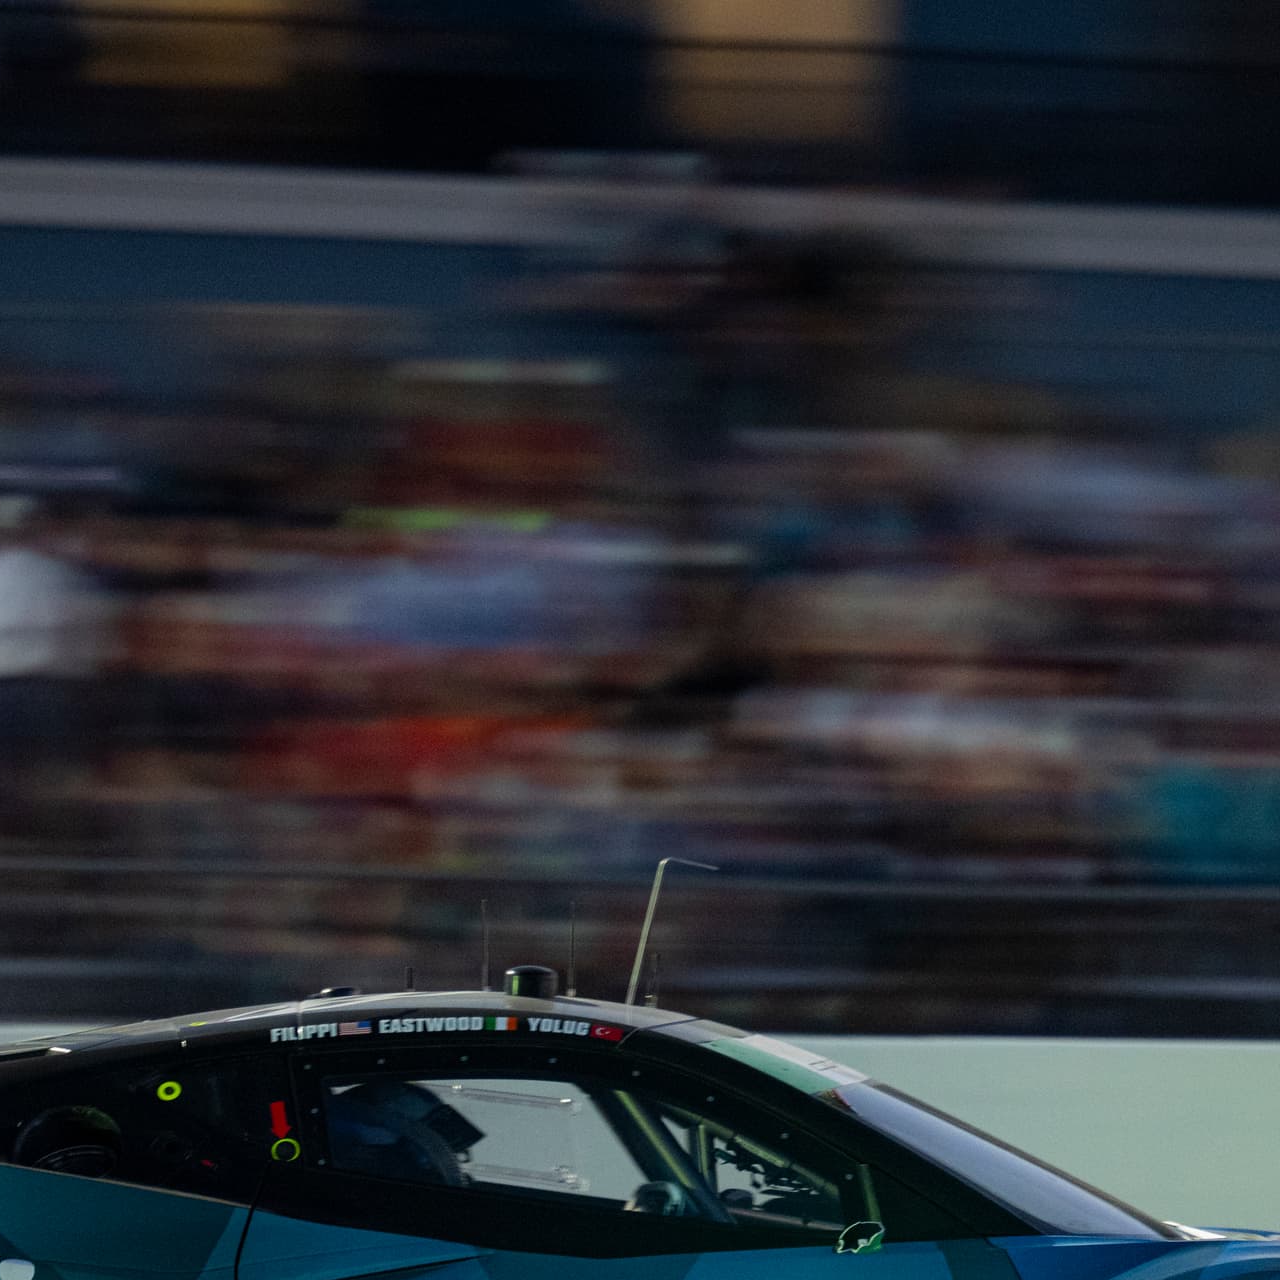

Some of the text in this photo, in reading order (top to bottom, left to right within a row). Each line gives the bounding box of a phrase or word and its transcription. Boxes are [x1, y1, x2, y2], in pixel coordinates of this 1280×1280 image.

[270, 1022, 338, 1043] FILIPPI
[378, 1016, 484, 1034] EASTWOOD
[527, 1017, 590, 1036] YOLUC
